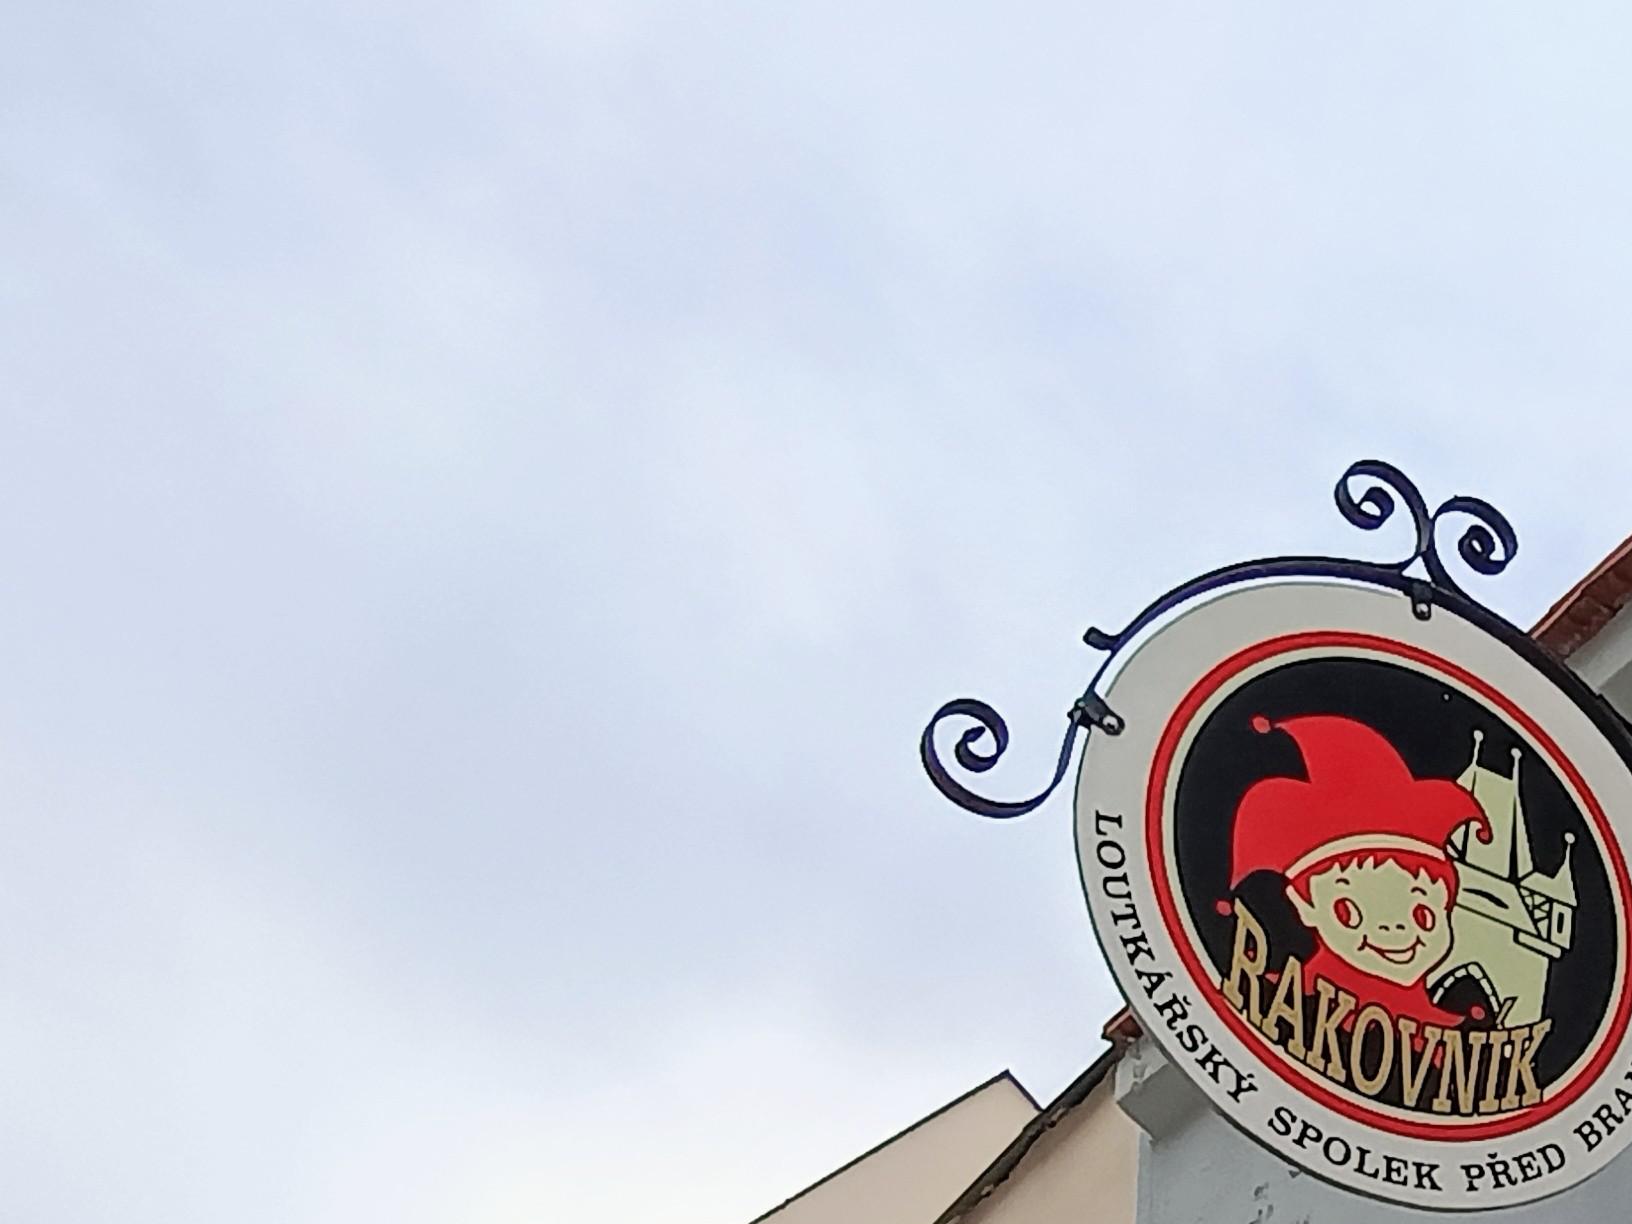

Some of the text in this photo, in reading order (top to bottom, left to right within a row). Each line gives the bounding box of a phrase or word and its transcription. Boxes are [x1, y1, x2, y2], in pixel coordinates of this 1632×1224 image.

[1095, 809, 1258, 1103] LOUTKÁŘSKÝ
[1267, 1106, 1442, 1191] SPOLEK
[1460, 1142, 1566, 1192] PŘED
[1222, 897, 1552, 1113] RAKOVNÍK
